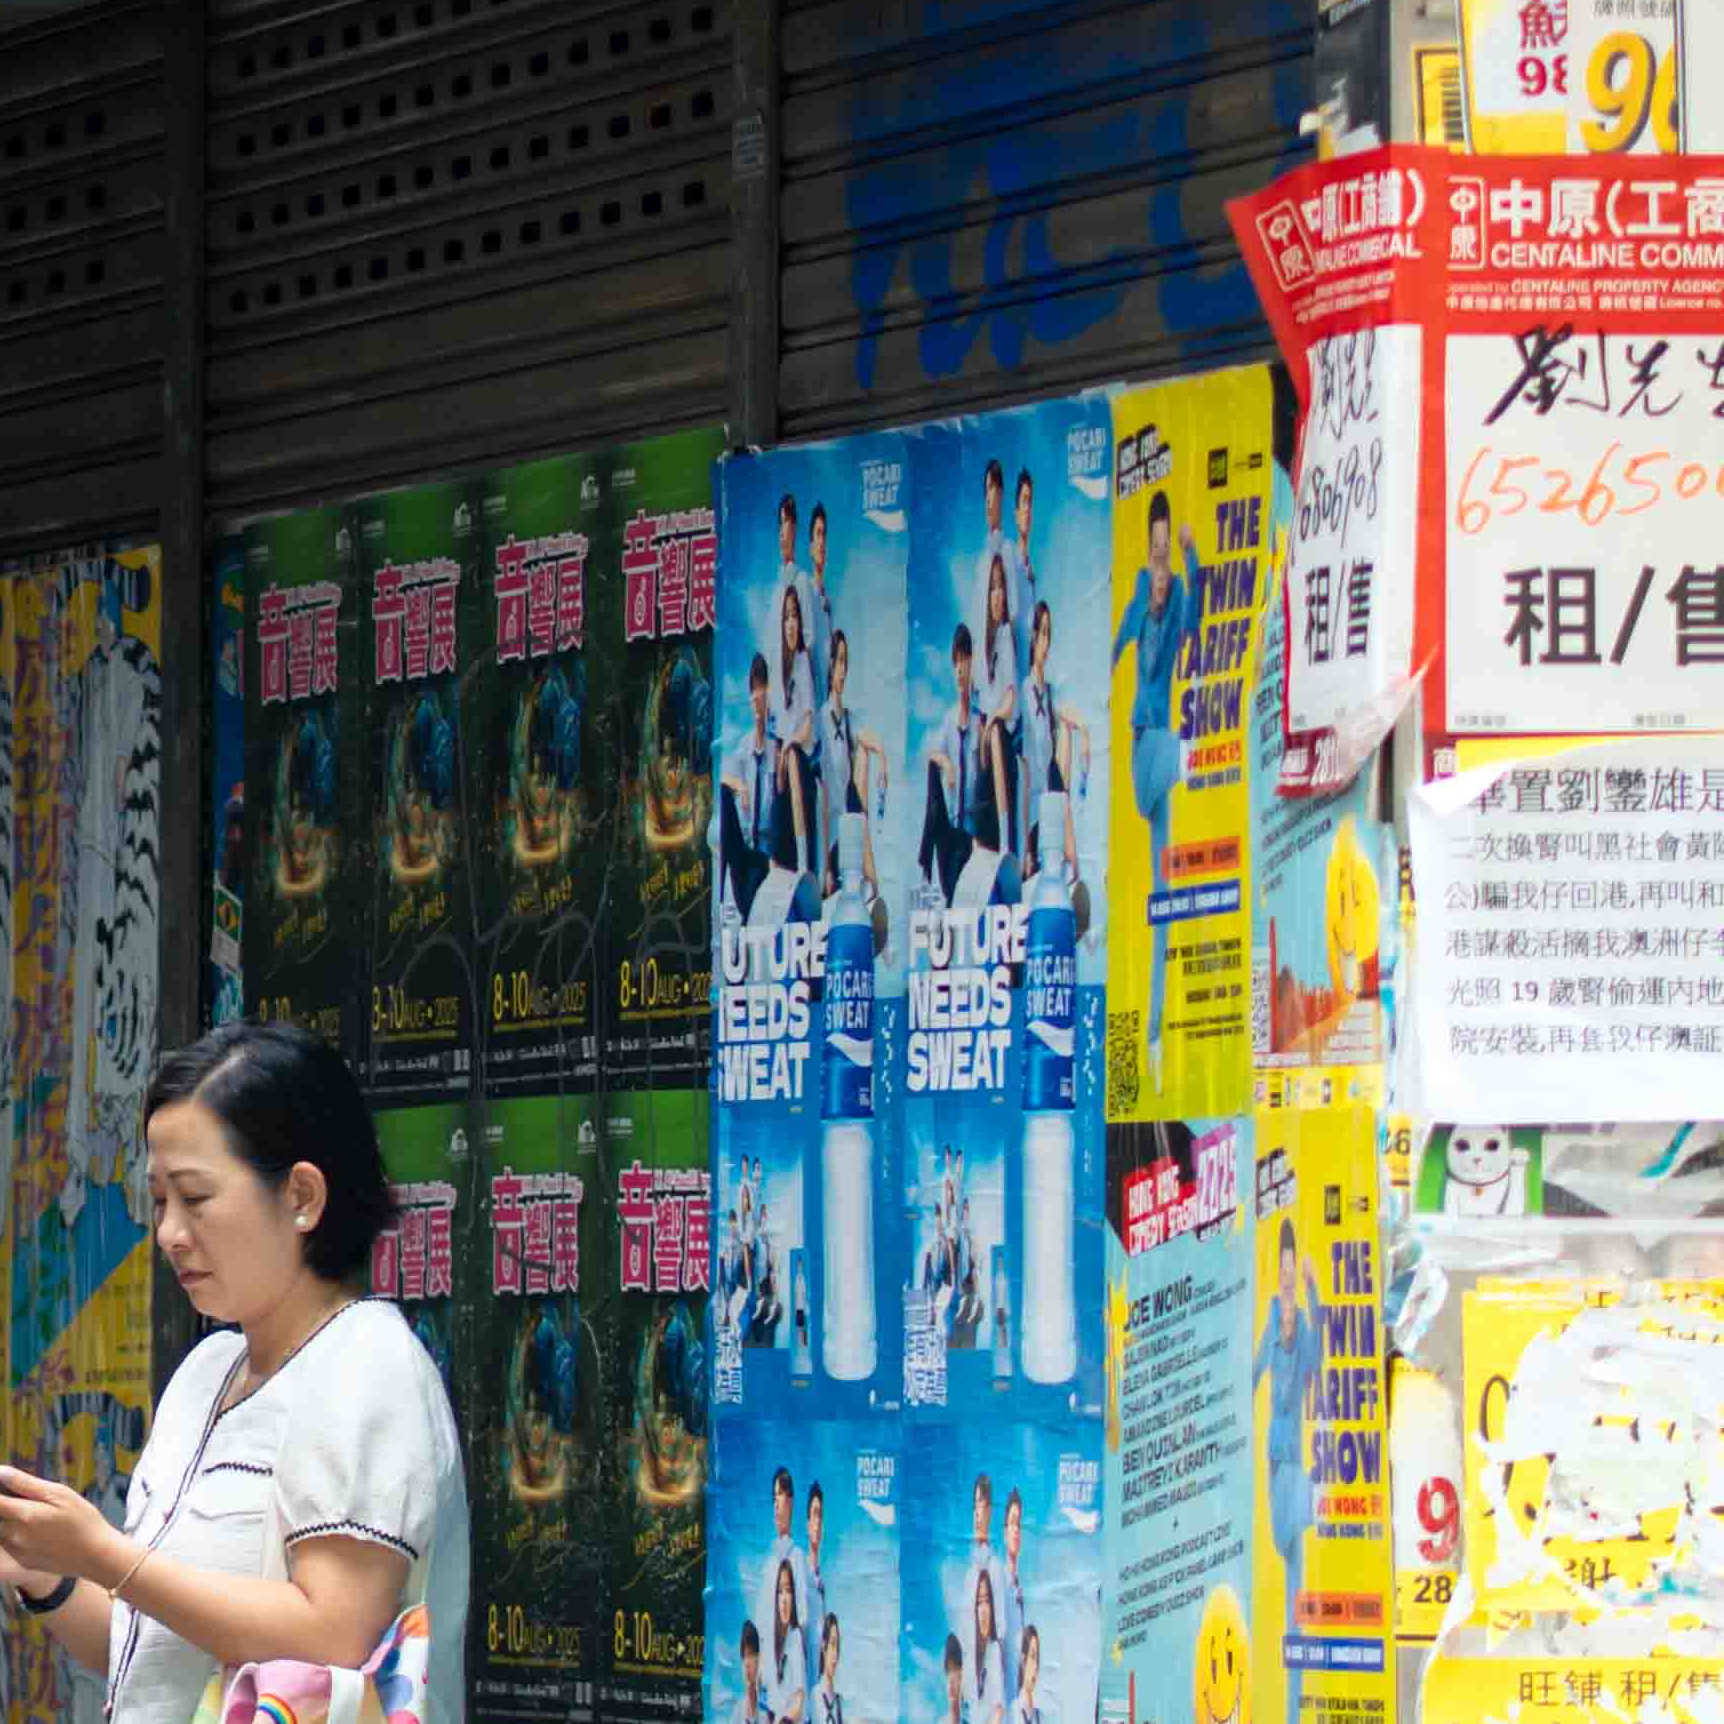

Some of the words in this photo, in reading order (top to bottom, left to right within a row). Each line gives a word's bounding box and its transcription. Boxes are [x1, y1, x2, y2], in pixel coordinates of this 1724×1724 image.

[1490, 242, 1636, 268] CENTALINE
[1511, 278, 1590, 294] CENTALINE
[1592, 278, 1669, 294] PROPERTY
[1214, 495, 1262, 555] THE
[1197, 556, 1257, 618] TWIN
[1305, 556, 1375, 667] 租/售
[1504, 566, 1724, 668] 租/售
[1179, 678, 1245, 741] SHOW
[720, 919, 827, 984] UTURE
[908, 902, 1029, 970] FUTURE
[492, 969, 531, 1022] 8-10
[825, 969, 873, 1000] POCARI
[1026, 955, 1076, 987] POCARI
[1511, 979, 1540, 1004] 19
[825, 998, 870, 1032] SWEAT
[907, 965, 1011, 1033] NEEDS
[1026, 984, 1071, 1018] SWEAT
[906, 1028, 1012, 1094] SWEAT
[1153, 1275, 1194, 1314] WONG
[1331, 1241, 1372, 1295] THE
[1310, 1429, 1381, 1486] SHOW
[1413, 1574, 1454, 1605] 28
[487, 1603, 525, 1654] 8-10
[613, 1608, 651, 1662] 8-10
